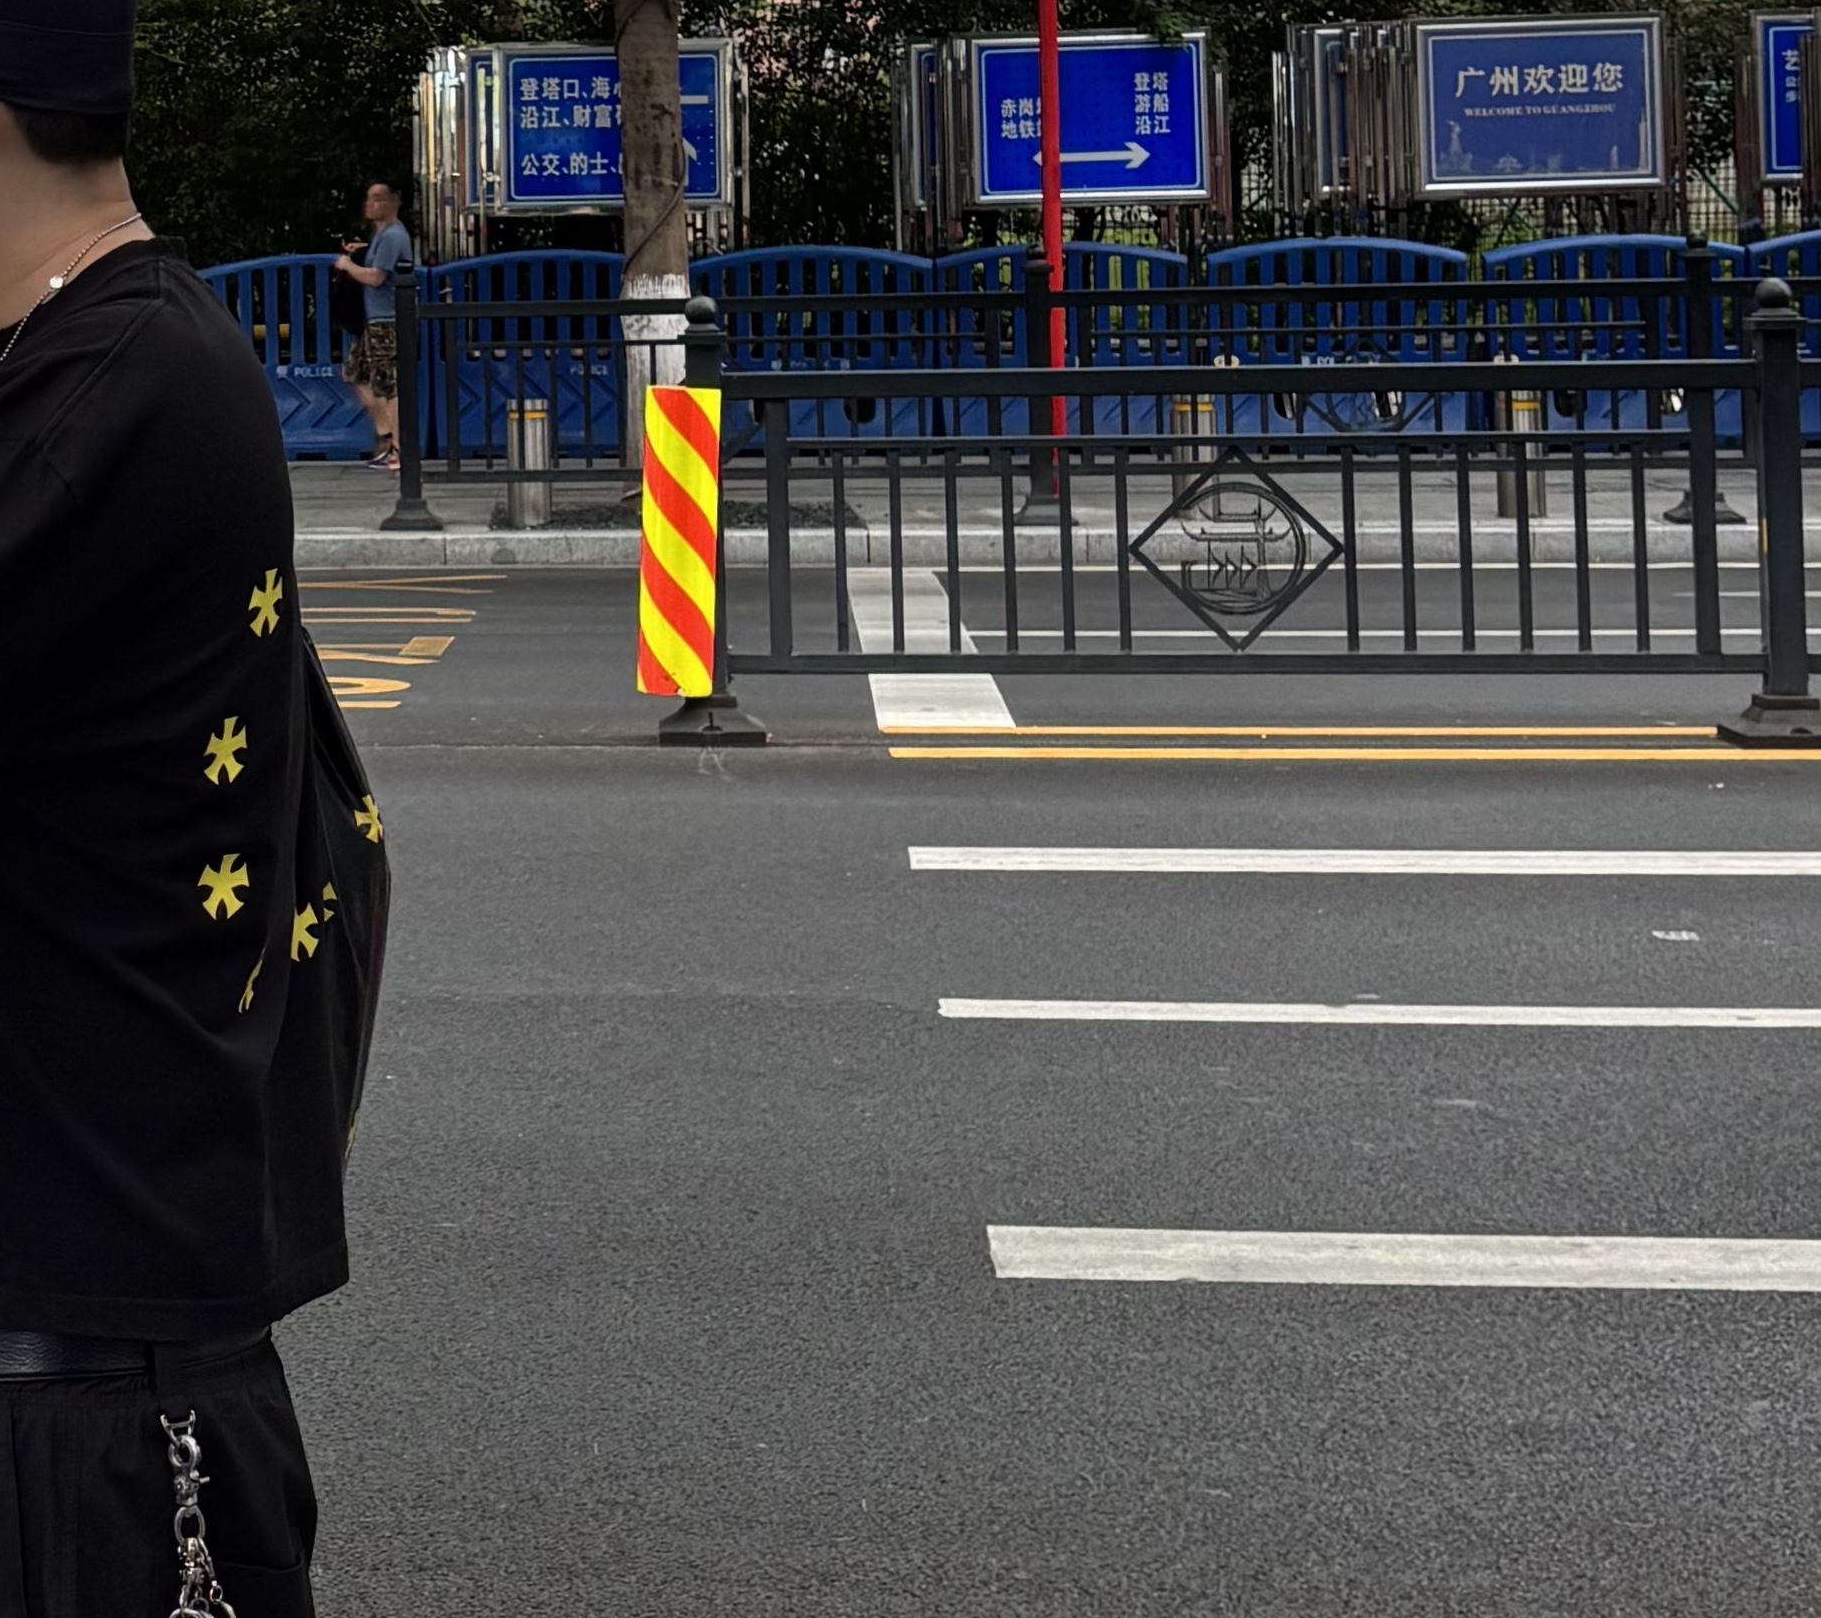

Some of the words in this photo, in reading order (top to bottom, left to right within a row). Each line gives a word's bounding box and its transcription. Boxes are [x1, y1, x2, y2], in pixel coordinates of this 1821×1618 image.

[1134, 72, 1169, 92] 登塔
[1455, 62, 1625, 99] 广州欢迎您
[1134, 93, 1170, 114] 游船
[1464, 106, 1524, 117] WELCOME
[1525, 105, 1541, 115] TO
[1543, 103, 1617, 115] GUANGZHOU
[1135, 115, 1171, 136] 沿江
[520, 152, 623, 177] 公交、的士、
